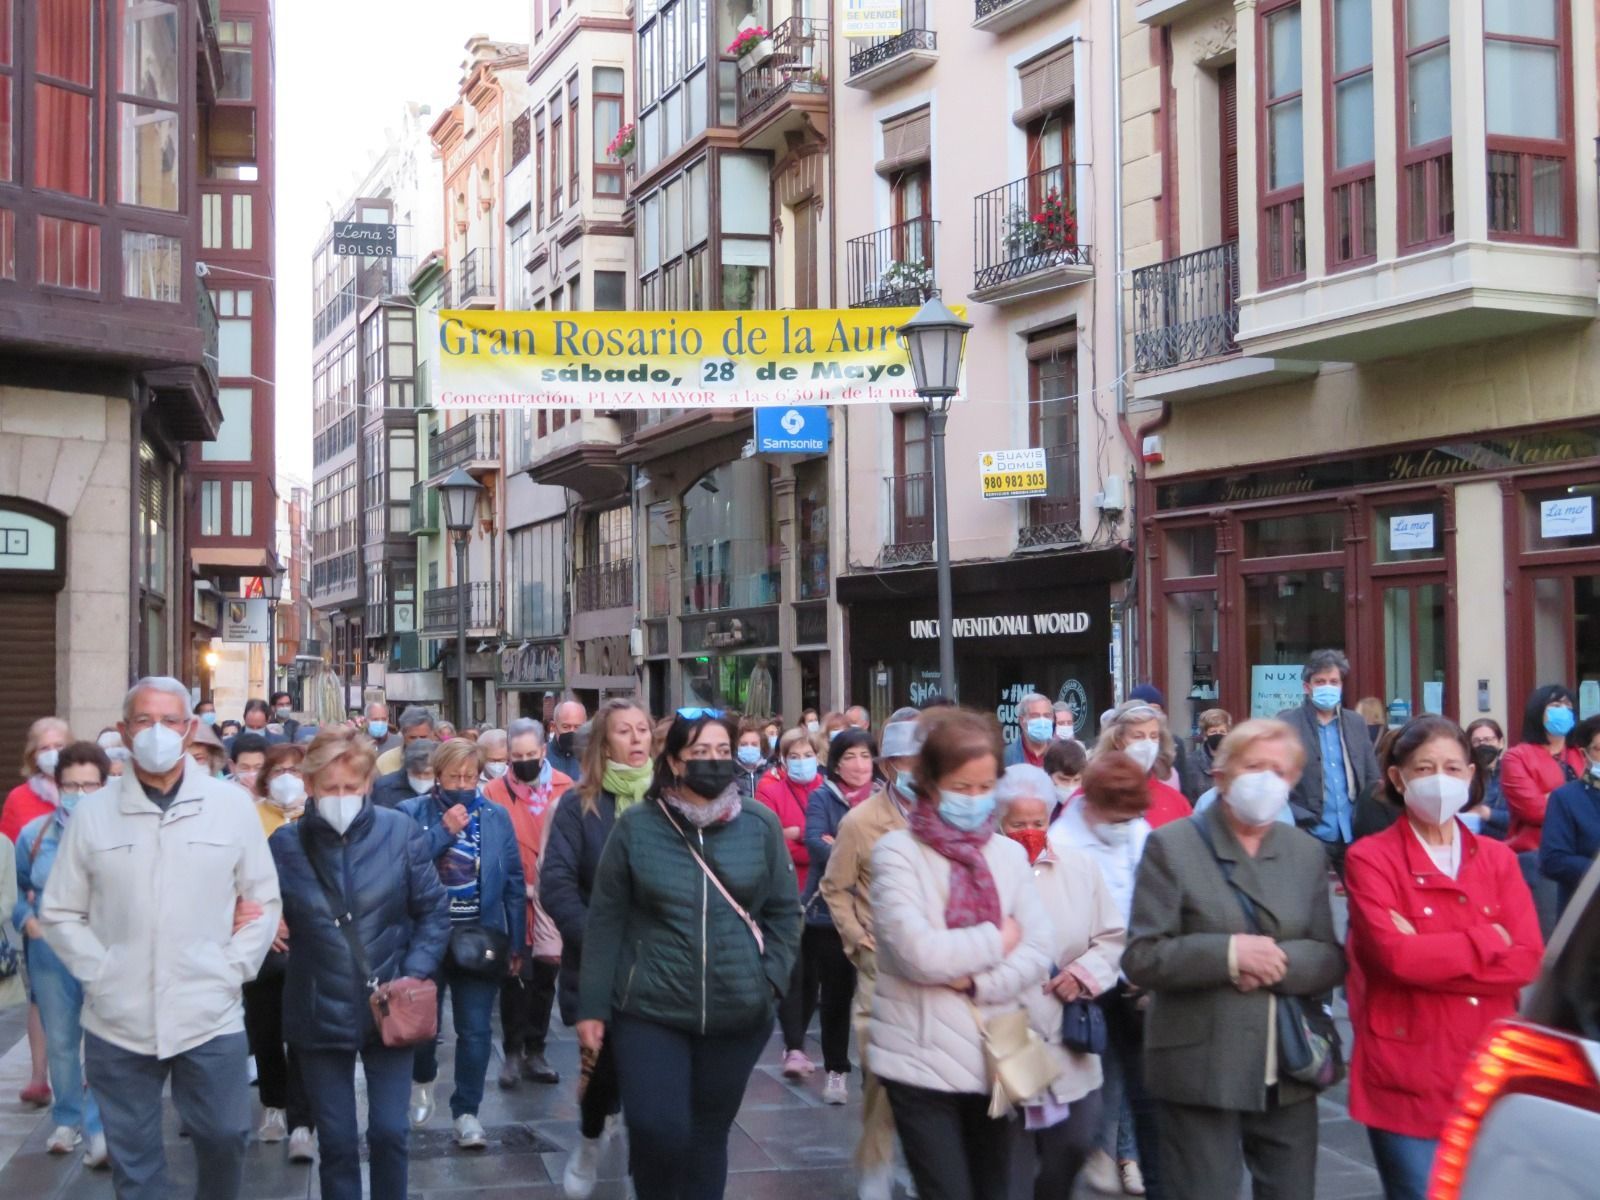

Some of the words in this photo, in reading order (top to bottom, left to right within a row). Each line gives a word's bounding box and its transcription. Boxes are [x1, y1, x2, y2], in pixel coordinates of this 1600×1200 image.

[864, 10, 897, 19] VENDE
[335, 223, 382, 240] Lema
[386, 226, 396, 240] 3
[338, 244, 393, 256] BOLSOS
[439, 318, 537, 356] Gran
[552, 318, 703, 357] Rosario
[722, 315, 768, 356] de
[782, 315, 816, 355] la
[540, 363, 683, 387] sábado,
[703, 361, 736, 383] 28
[755, 361, 799, 382] de
[810, 361, 906, 383] Mayo
[588, 391, 645, 404] PLAZA
[652, 391, 715, 404] MAYOR
[729, 392, 739, 402] a
[745, 390, 769, 402] las
[842, 387, 862, 400] de
[868, 386, 884, 399] la
[762, 438, 824, 449] Samsonite
[996, 450, 1043, 461] SUAVIS
[997, 461, 1043, 471] DOMUS
[984, 476, 1002, 489] 980
[1005, 474, 1024, 488] 982
[1026, 472, 1045, 486] 303
[1221, 475, 1315, 501] Farmacia
[1546, 503, 1563, 517] La
[1564, 504, 1588, 515] mer
[1394, 519, 1408, 532] La
[1410, 521, 1430, 531] mer
[910, 614, 1032, 639] UNCVENTIONAL
[1033, 612, 1090, 635] WORLD
[1264, 672, 1303, 681] NUX
